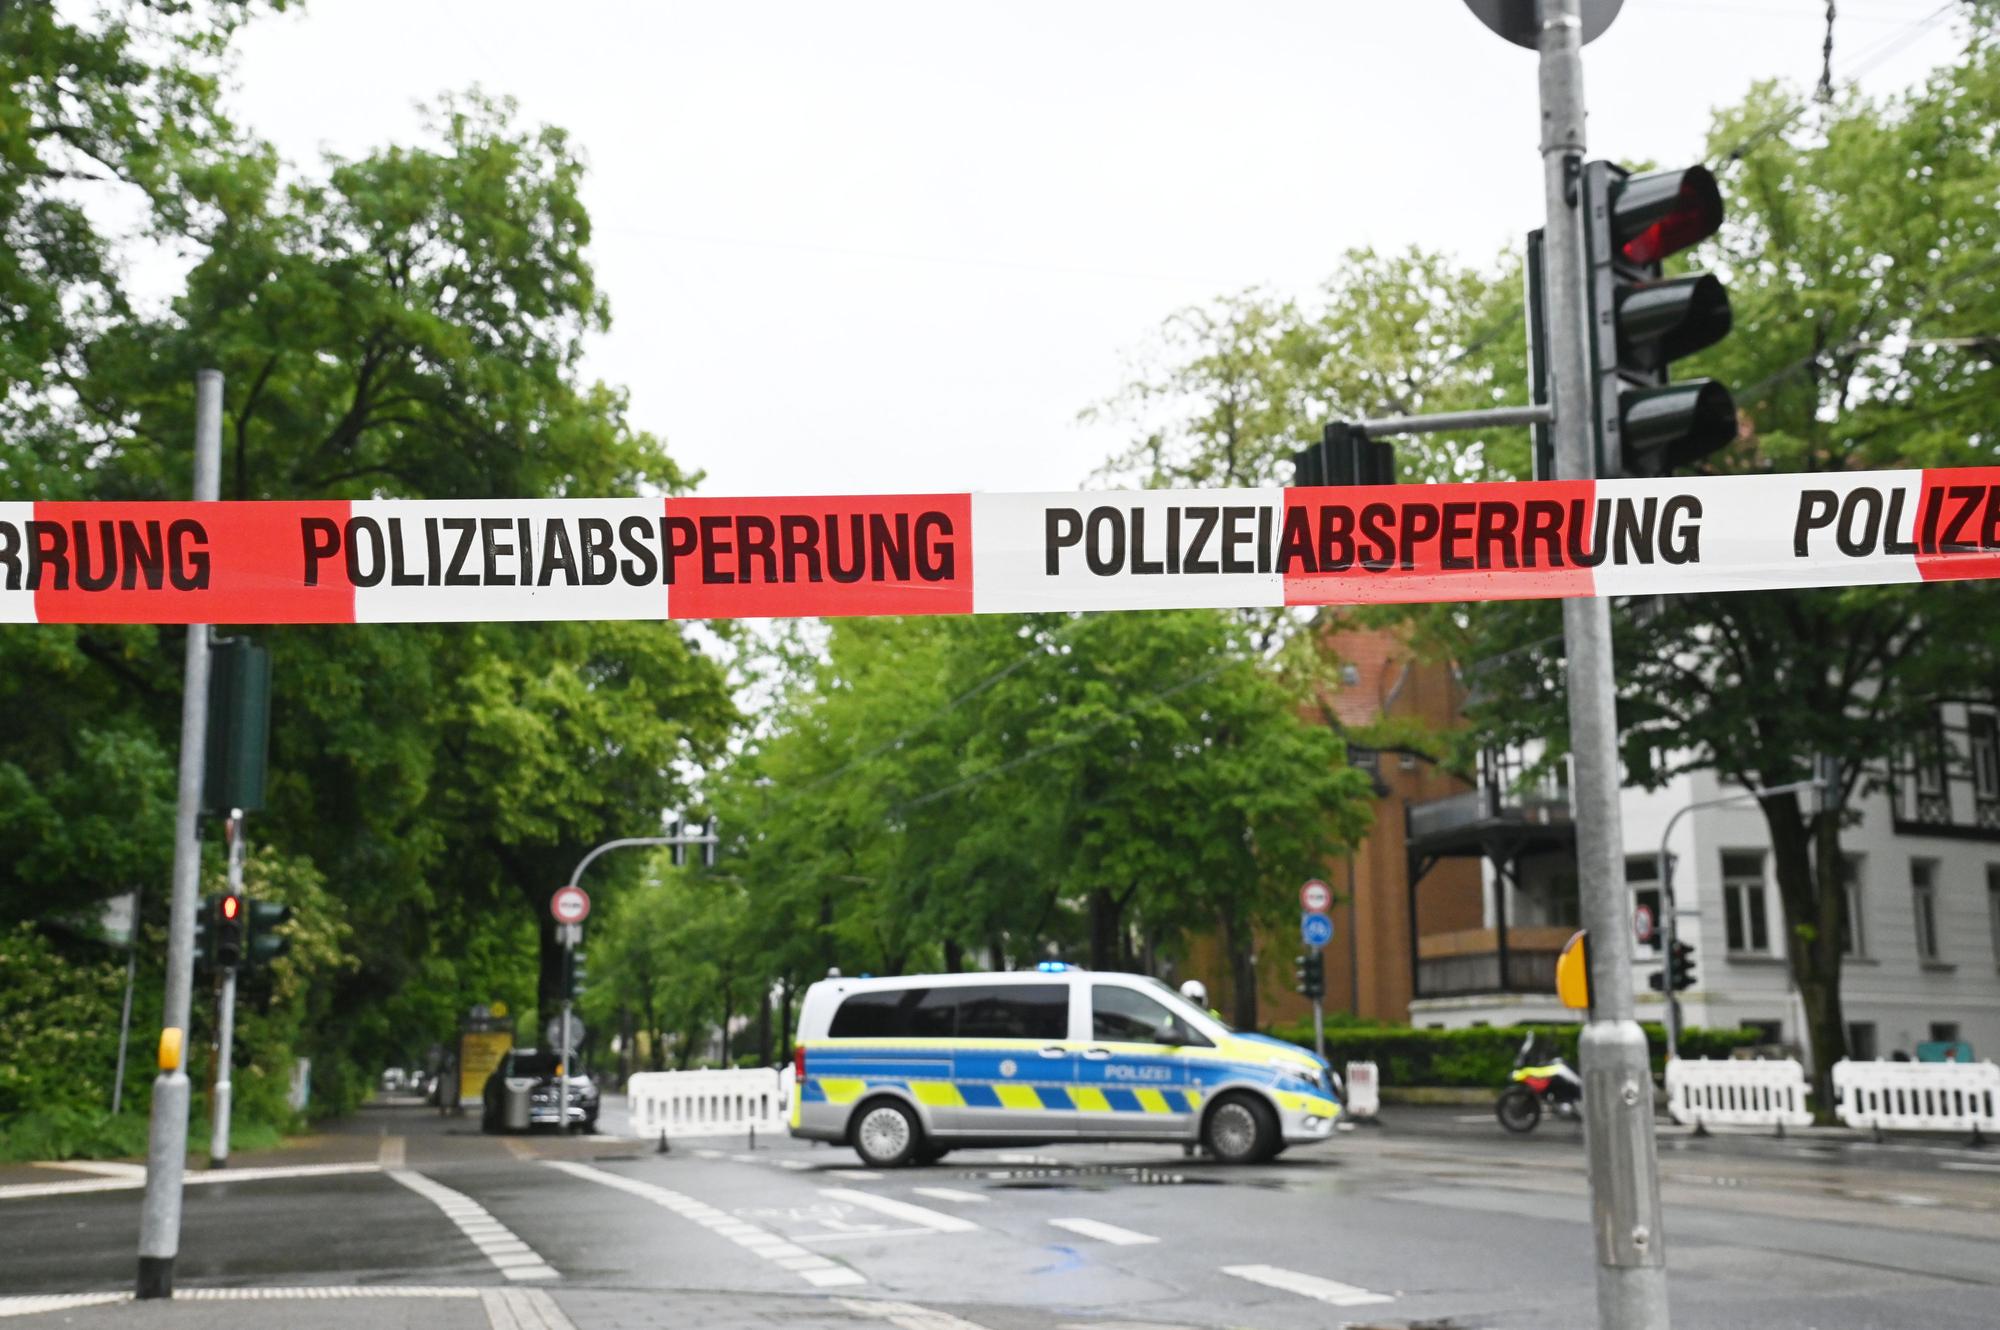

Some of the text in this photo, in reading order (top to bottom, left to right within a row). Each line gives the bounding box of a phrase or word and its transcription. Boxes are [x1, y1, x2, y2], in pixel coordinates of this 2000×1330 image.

[301, 511, 955, 588] POLIZEIABSPERRUNG
[1045, 494, 1703, 577] POLIZEIABSPERRUNG
[1104, 1063, 1172, 1081] POLIZEI
